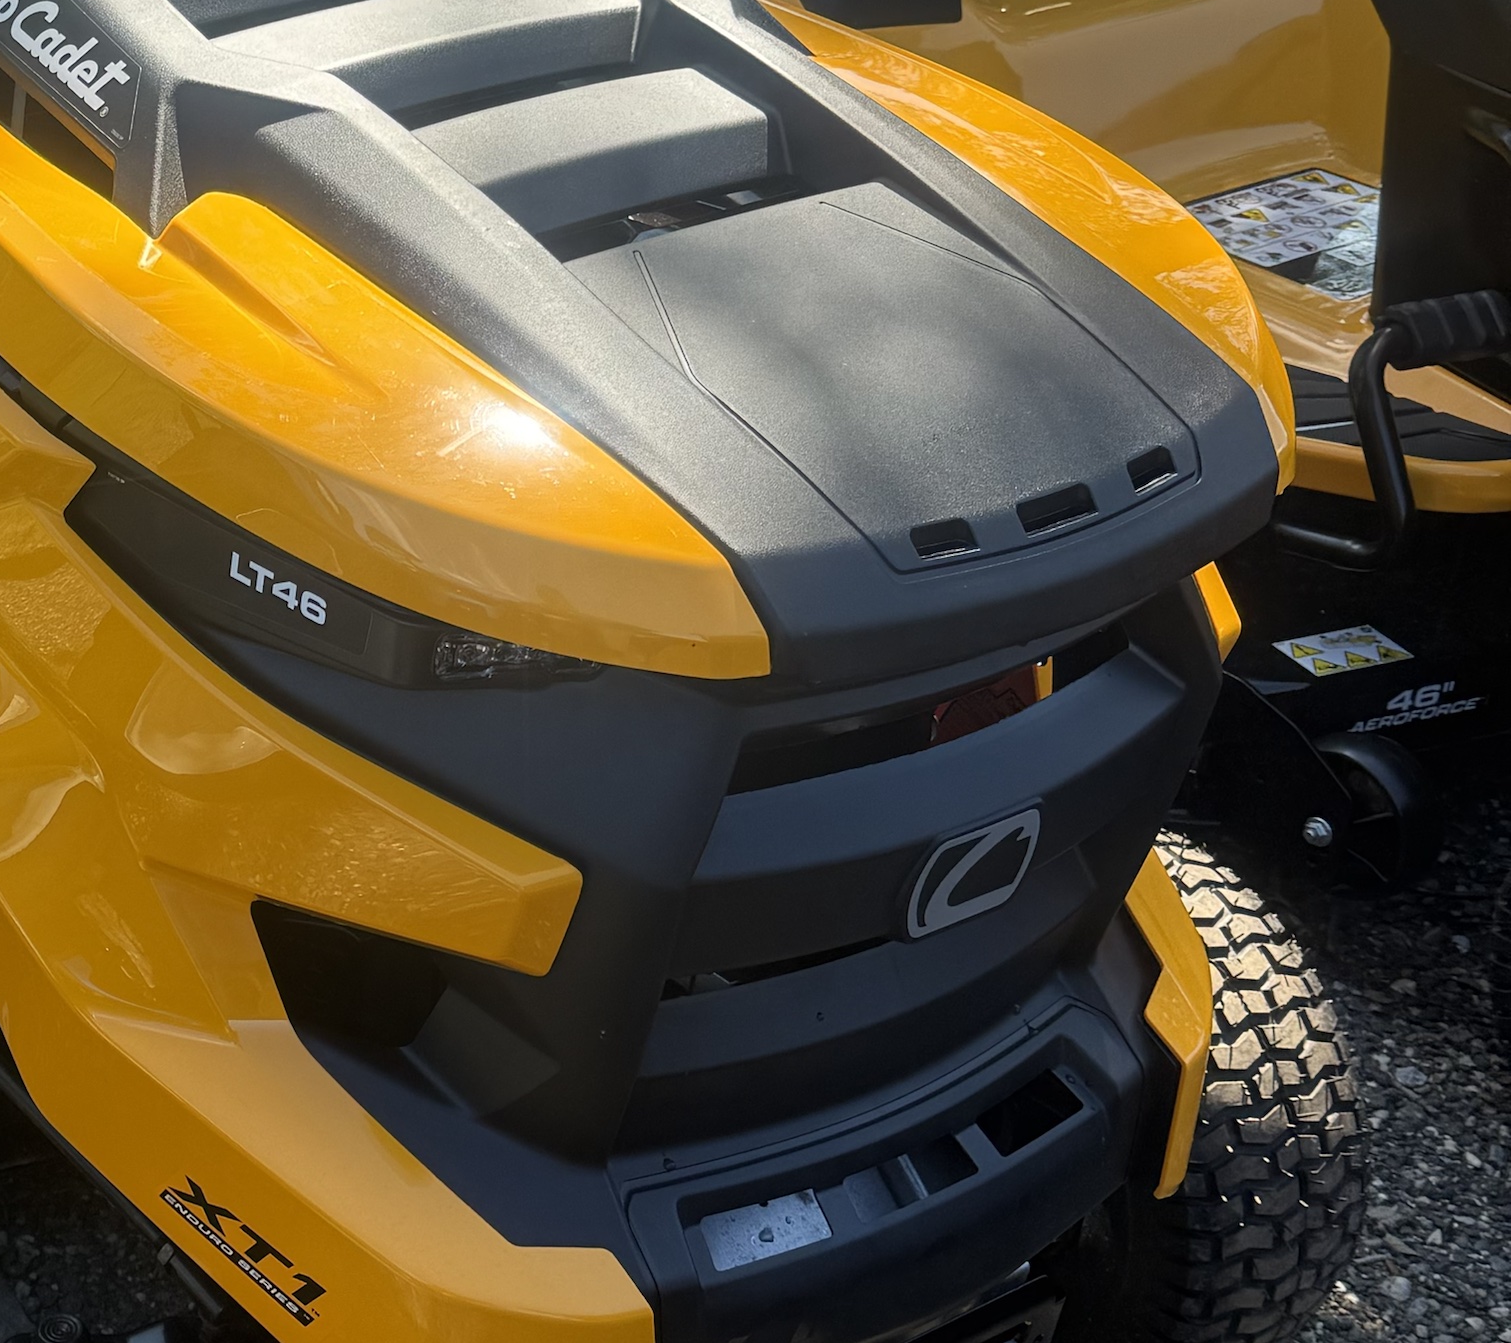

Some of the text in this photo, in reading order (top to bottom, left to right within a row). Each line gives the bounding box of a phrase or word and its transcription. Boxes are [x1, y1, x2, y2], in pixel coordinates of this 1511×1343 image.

[11, 0, 131, 112] Cadet
[229, 551, 327, 625] LT46
[1347, 697, 1485, 732] AEROFORCE
[1386, 681, 1455, 711] 46"
[163, 1193, 299, 1314] ENDURO SERIES
[167, 1174, 327, 1306] XT1
